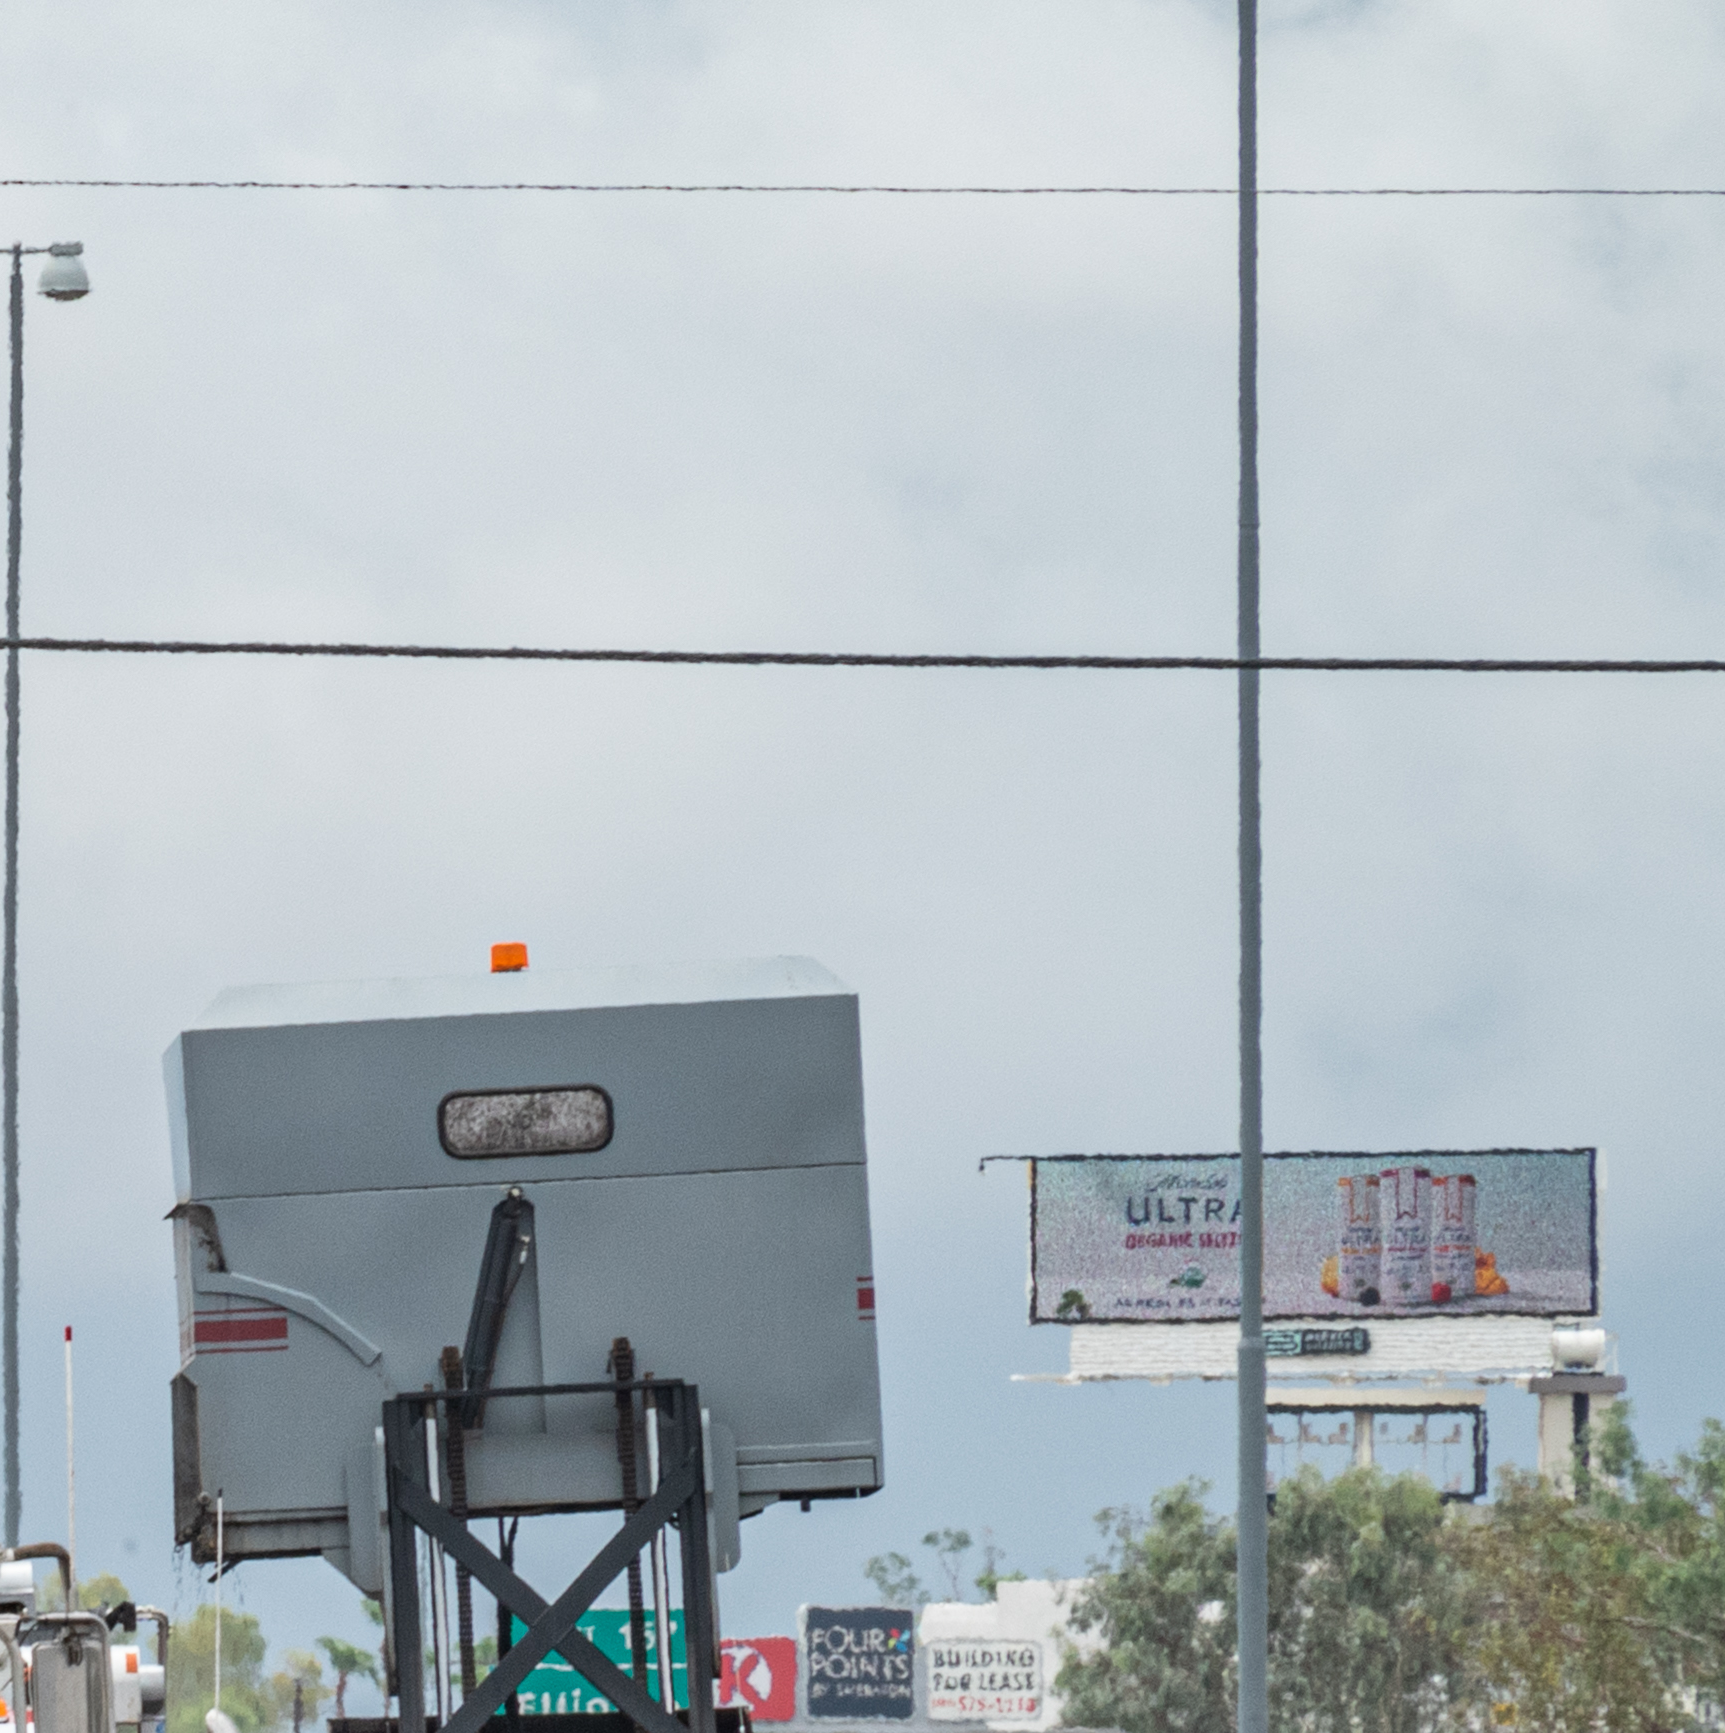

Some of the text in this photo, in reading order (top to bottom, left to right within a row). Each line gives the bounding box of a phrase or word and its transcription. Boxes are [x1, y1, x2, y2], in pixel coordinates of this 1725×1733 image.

[1199, 1232, 1241, 1248] SELTZ
[811, 1625, 884, 1653] FOUR
[811, 1652, 909, 1680] POINTS
[933, 1650, 1035, 1667] BUILDING
[933, 1672, 1035, 1691] FOR LEASE
[517, 1687, 610, 1715] Ellio
